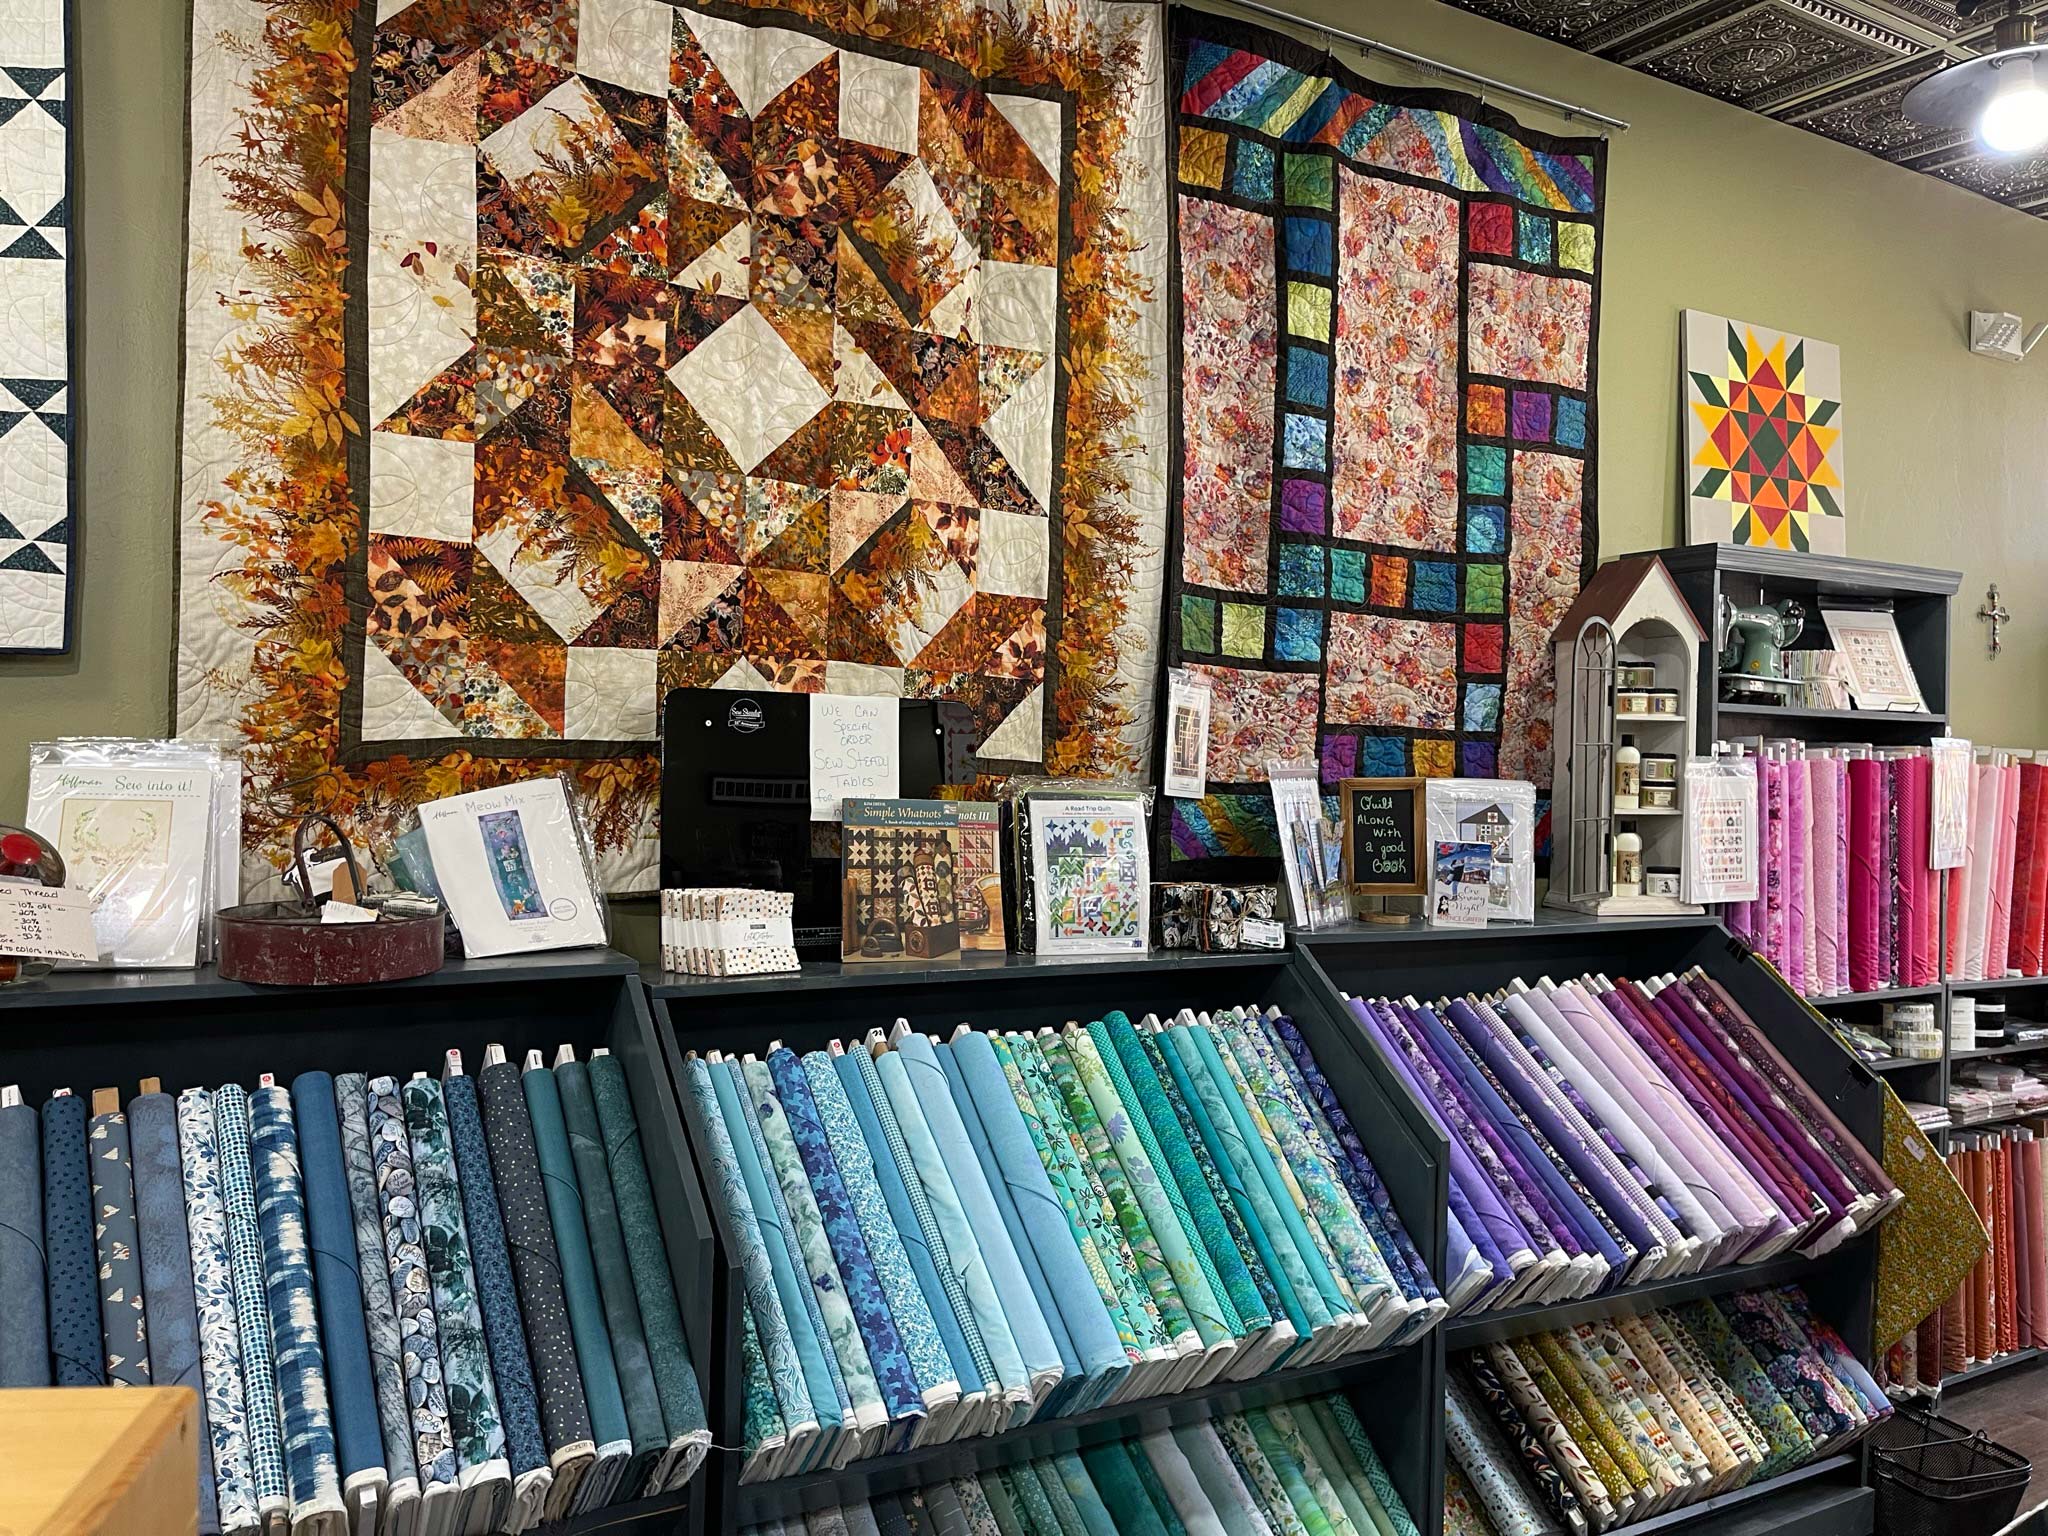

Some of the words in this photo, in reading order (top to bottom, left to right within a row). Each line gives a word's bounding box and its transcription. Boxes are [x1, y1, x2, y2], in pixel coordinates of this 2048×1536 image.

[821, 706, 842, 717] WE
[854, 705, 878, 718] CAN
[840, 735, 873, 746] ORDER
[55, 774, 103, 787] Hoffman
[115, 775, 143, 791] Sew
[147, 780, 173, 791] into
[178, 780, 193, 792] it!
[465, 801, 501, 813] Meow
[503, 794, 526, 807] Mix
[1360, 795, 1392, 810] Quilt
[864, 806, 895, 821] Simple
[898, 807, 942, 818] Whatnots
[1357, 814, 1394, 826] ALONG
[1365, 841, 1374, 852] a
[1380, 841, 1406, 860] good
[20, 889, 58, 898] Thread
